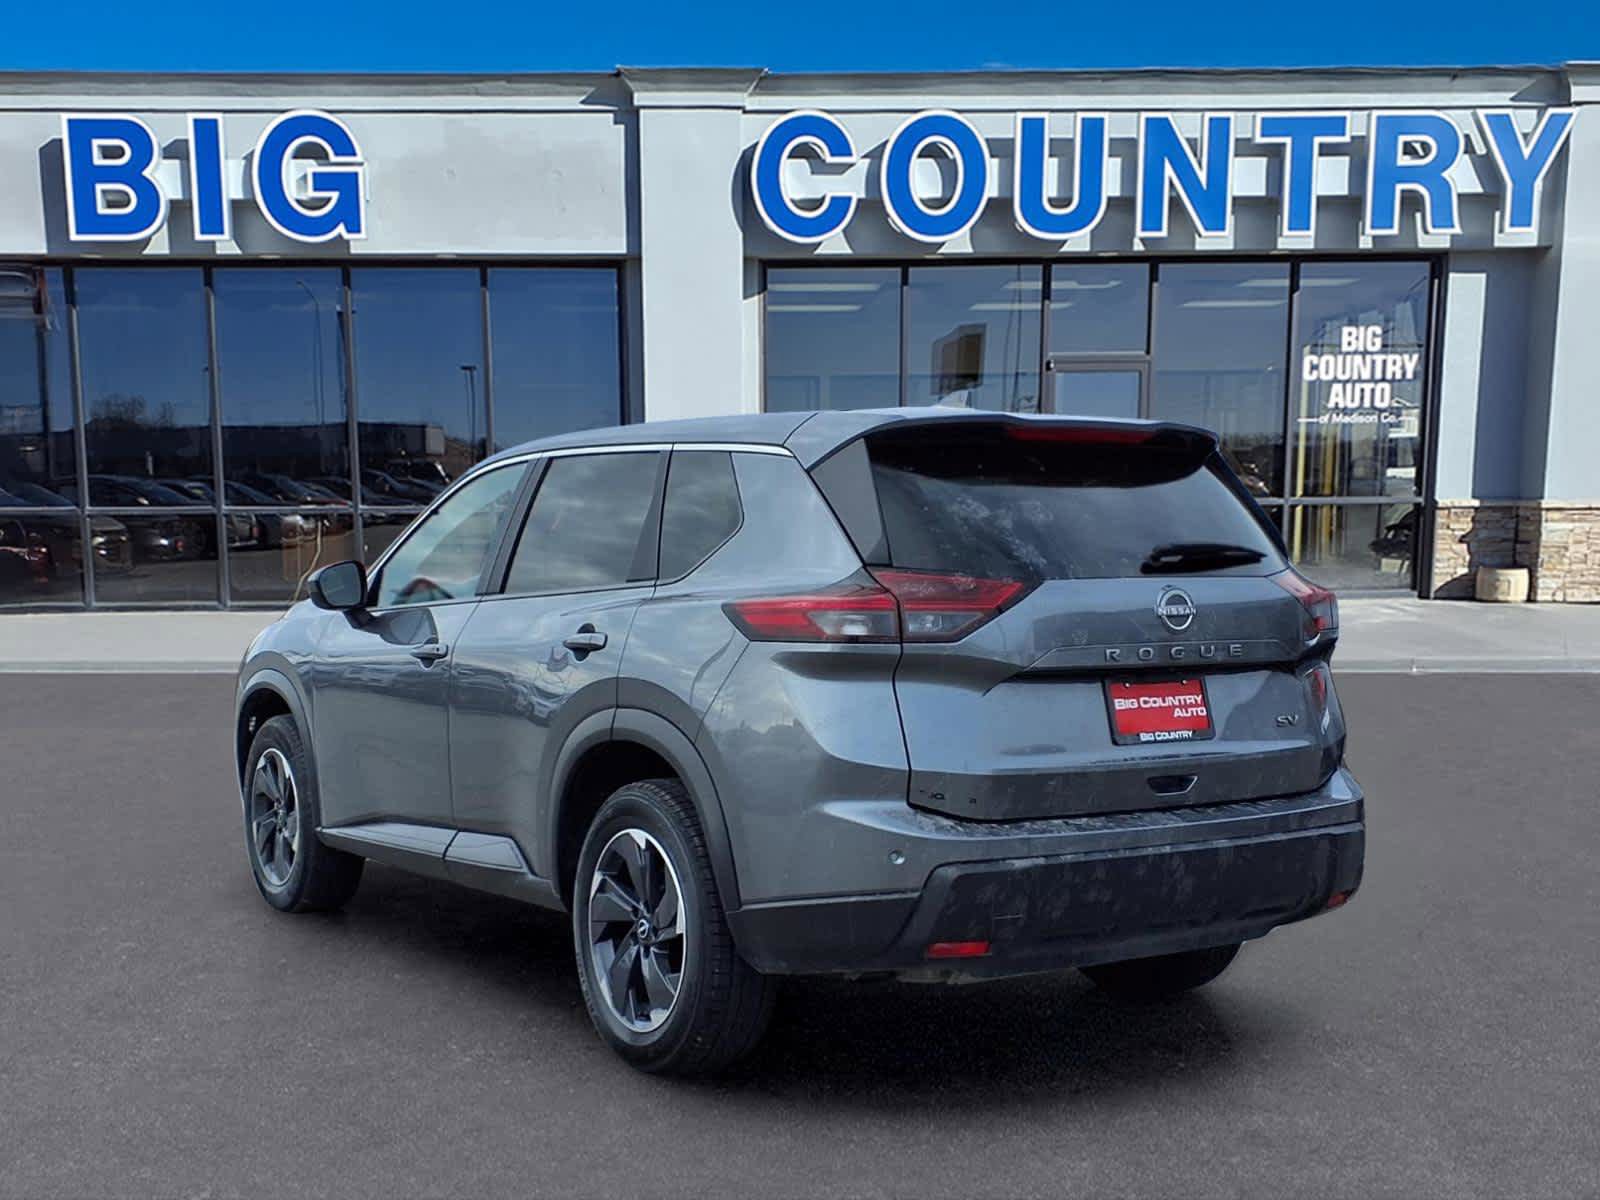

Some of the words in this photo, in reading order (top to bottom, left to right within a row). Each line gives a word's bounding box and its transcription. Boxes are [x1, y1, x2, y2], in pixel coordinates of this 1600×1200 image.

[61, 109, 366, 242] BIG
[751, 108, 1575, 245] COUNTRY
[1341, 325, 1382, 352] BIG
[1303, 353, 1419, 381] COUNTRY
[1327, 382, 1391, 409] AUTO
[1158, 605, 1196, 616] NISSAN
[1105, 644, 1243, 661] ROGUE
[1174, 707, 1207, 718] AUTO
[1277, 714, 1298, 727] SV
